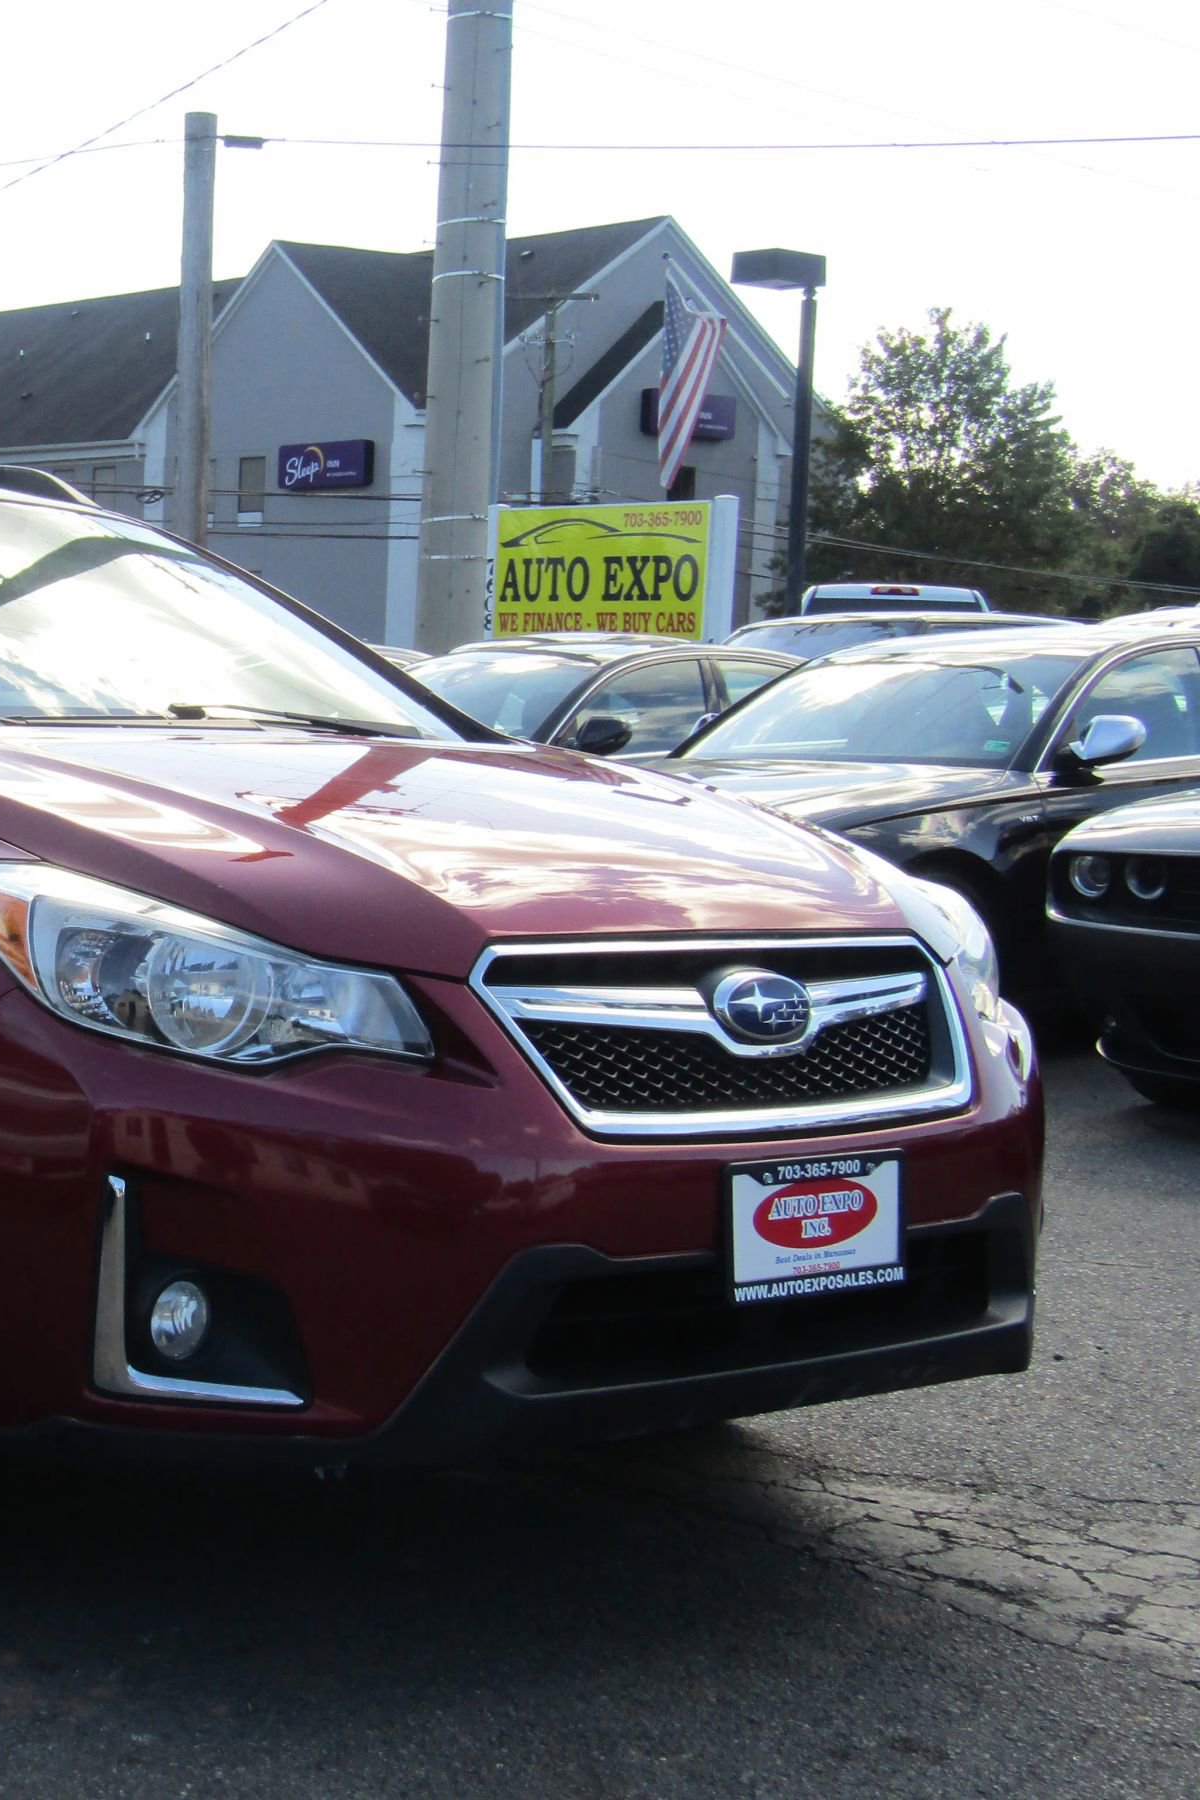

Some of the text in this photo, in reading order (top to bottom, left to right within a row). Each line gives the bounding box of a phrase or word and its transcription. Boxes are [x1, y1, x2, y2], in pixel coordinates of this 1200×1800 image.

[285, 456, 320, 486] Sleep
[624, 511, 702, 528] 703-365-7900
[500, 553, 699, 602] AUTO EXPO
[499, 612, 518, 633] WE
[522, 611, 583, 633] FINANCE
[596, 612, 618, 633] WE
[622, 612, 653, 633] BUY
[656, 612, 696, 633] CARS
[777, 1159, 861, 1181] 703-365-7900
[768, 1189, 864, 1220] AUTO EXPO
[801, 1217, 832, 1239] INC.
[775, 1256, 791, 1265] Best
[793, 1253, 813, 1263] Deals
[814, 1252, 822, 1260] in
[734, 1266, 904, 1302] WWW.AUTOEXPOSALES.COM
